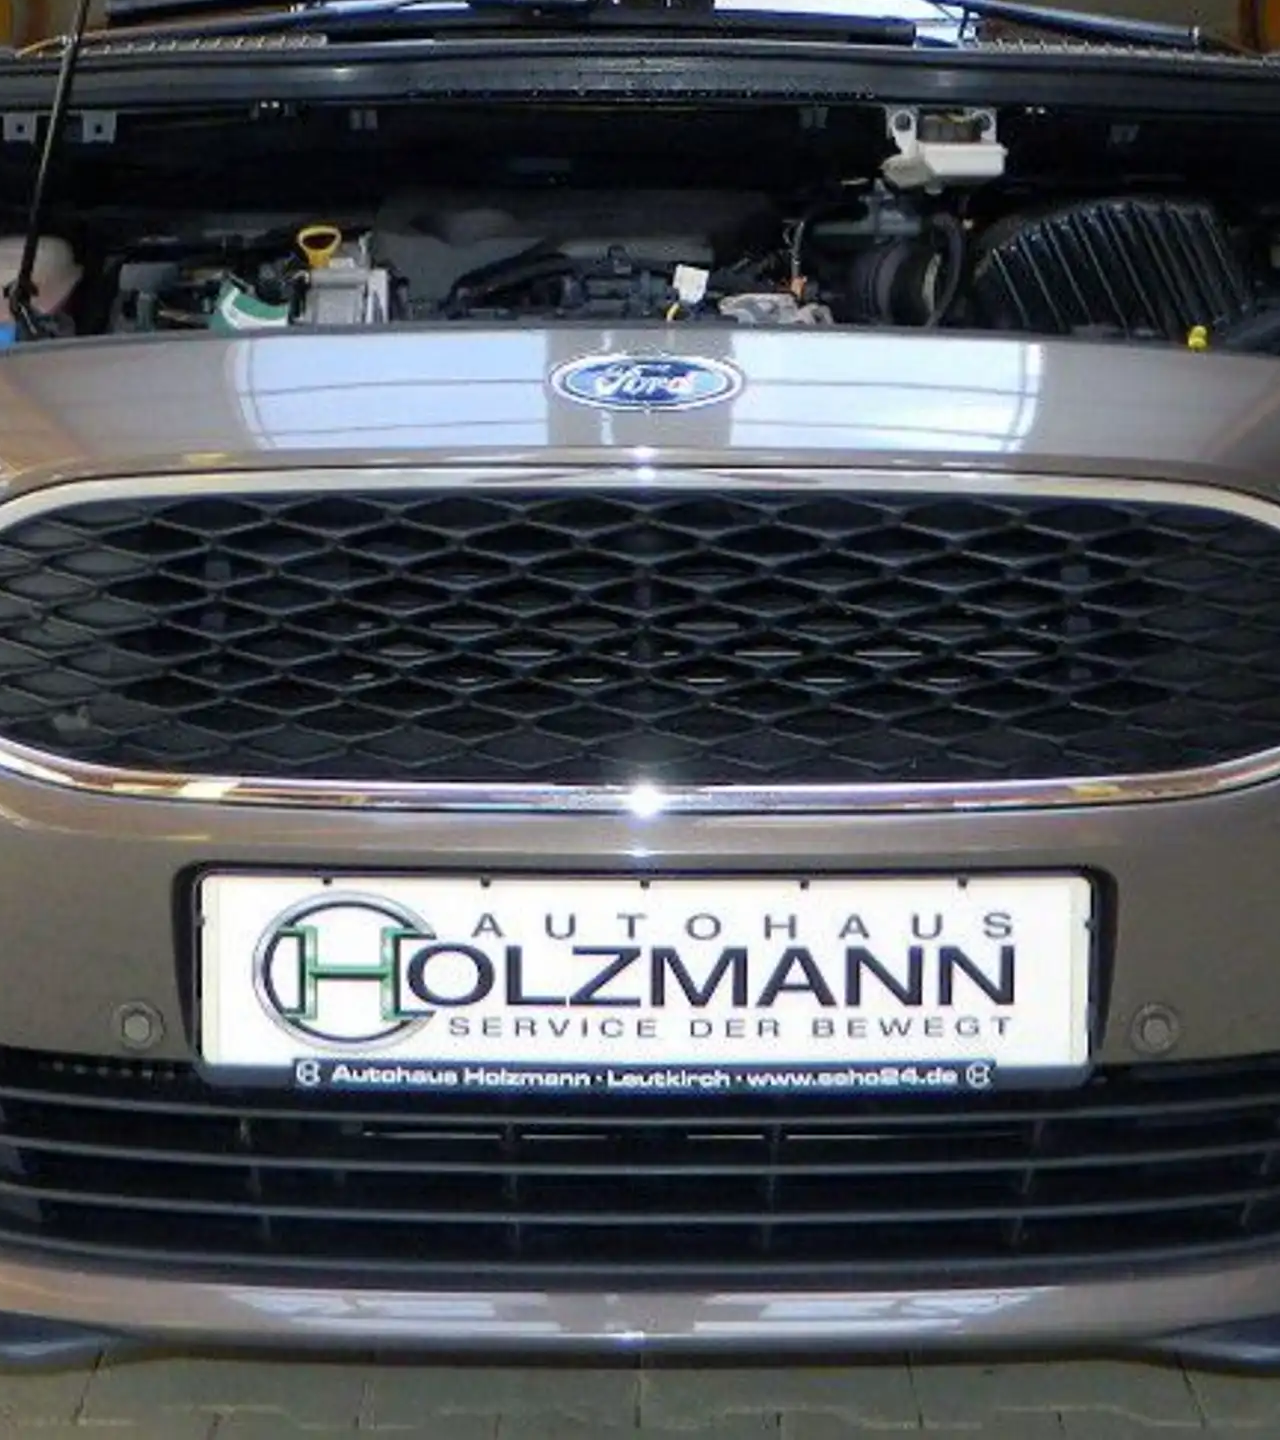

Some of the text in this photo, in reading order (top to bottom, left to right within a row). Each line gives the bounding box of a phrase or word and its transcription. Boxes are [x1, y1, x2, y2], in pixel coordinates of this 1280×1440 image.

[595, 363, 699, 396] Ford
[471, 912, 1014, 940] AUTOHAUS
[258, 925, 1015, 1020] HOLZMANN
[448, 1016, 1012, 1038] SERVICE DER BEWEGT
[331, 1063, 458, 1086] Autohaus
[464, 1066, 591, 1087] Holzmann
